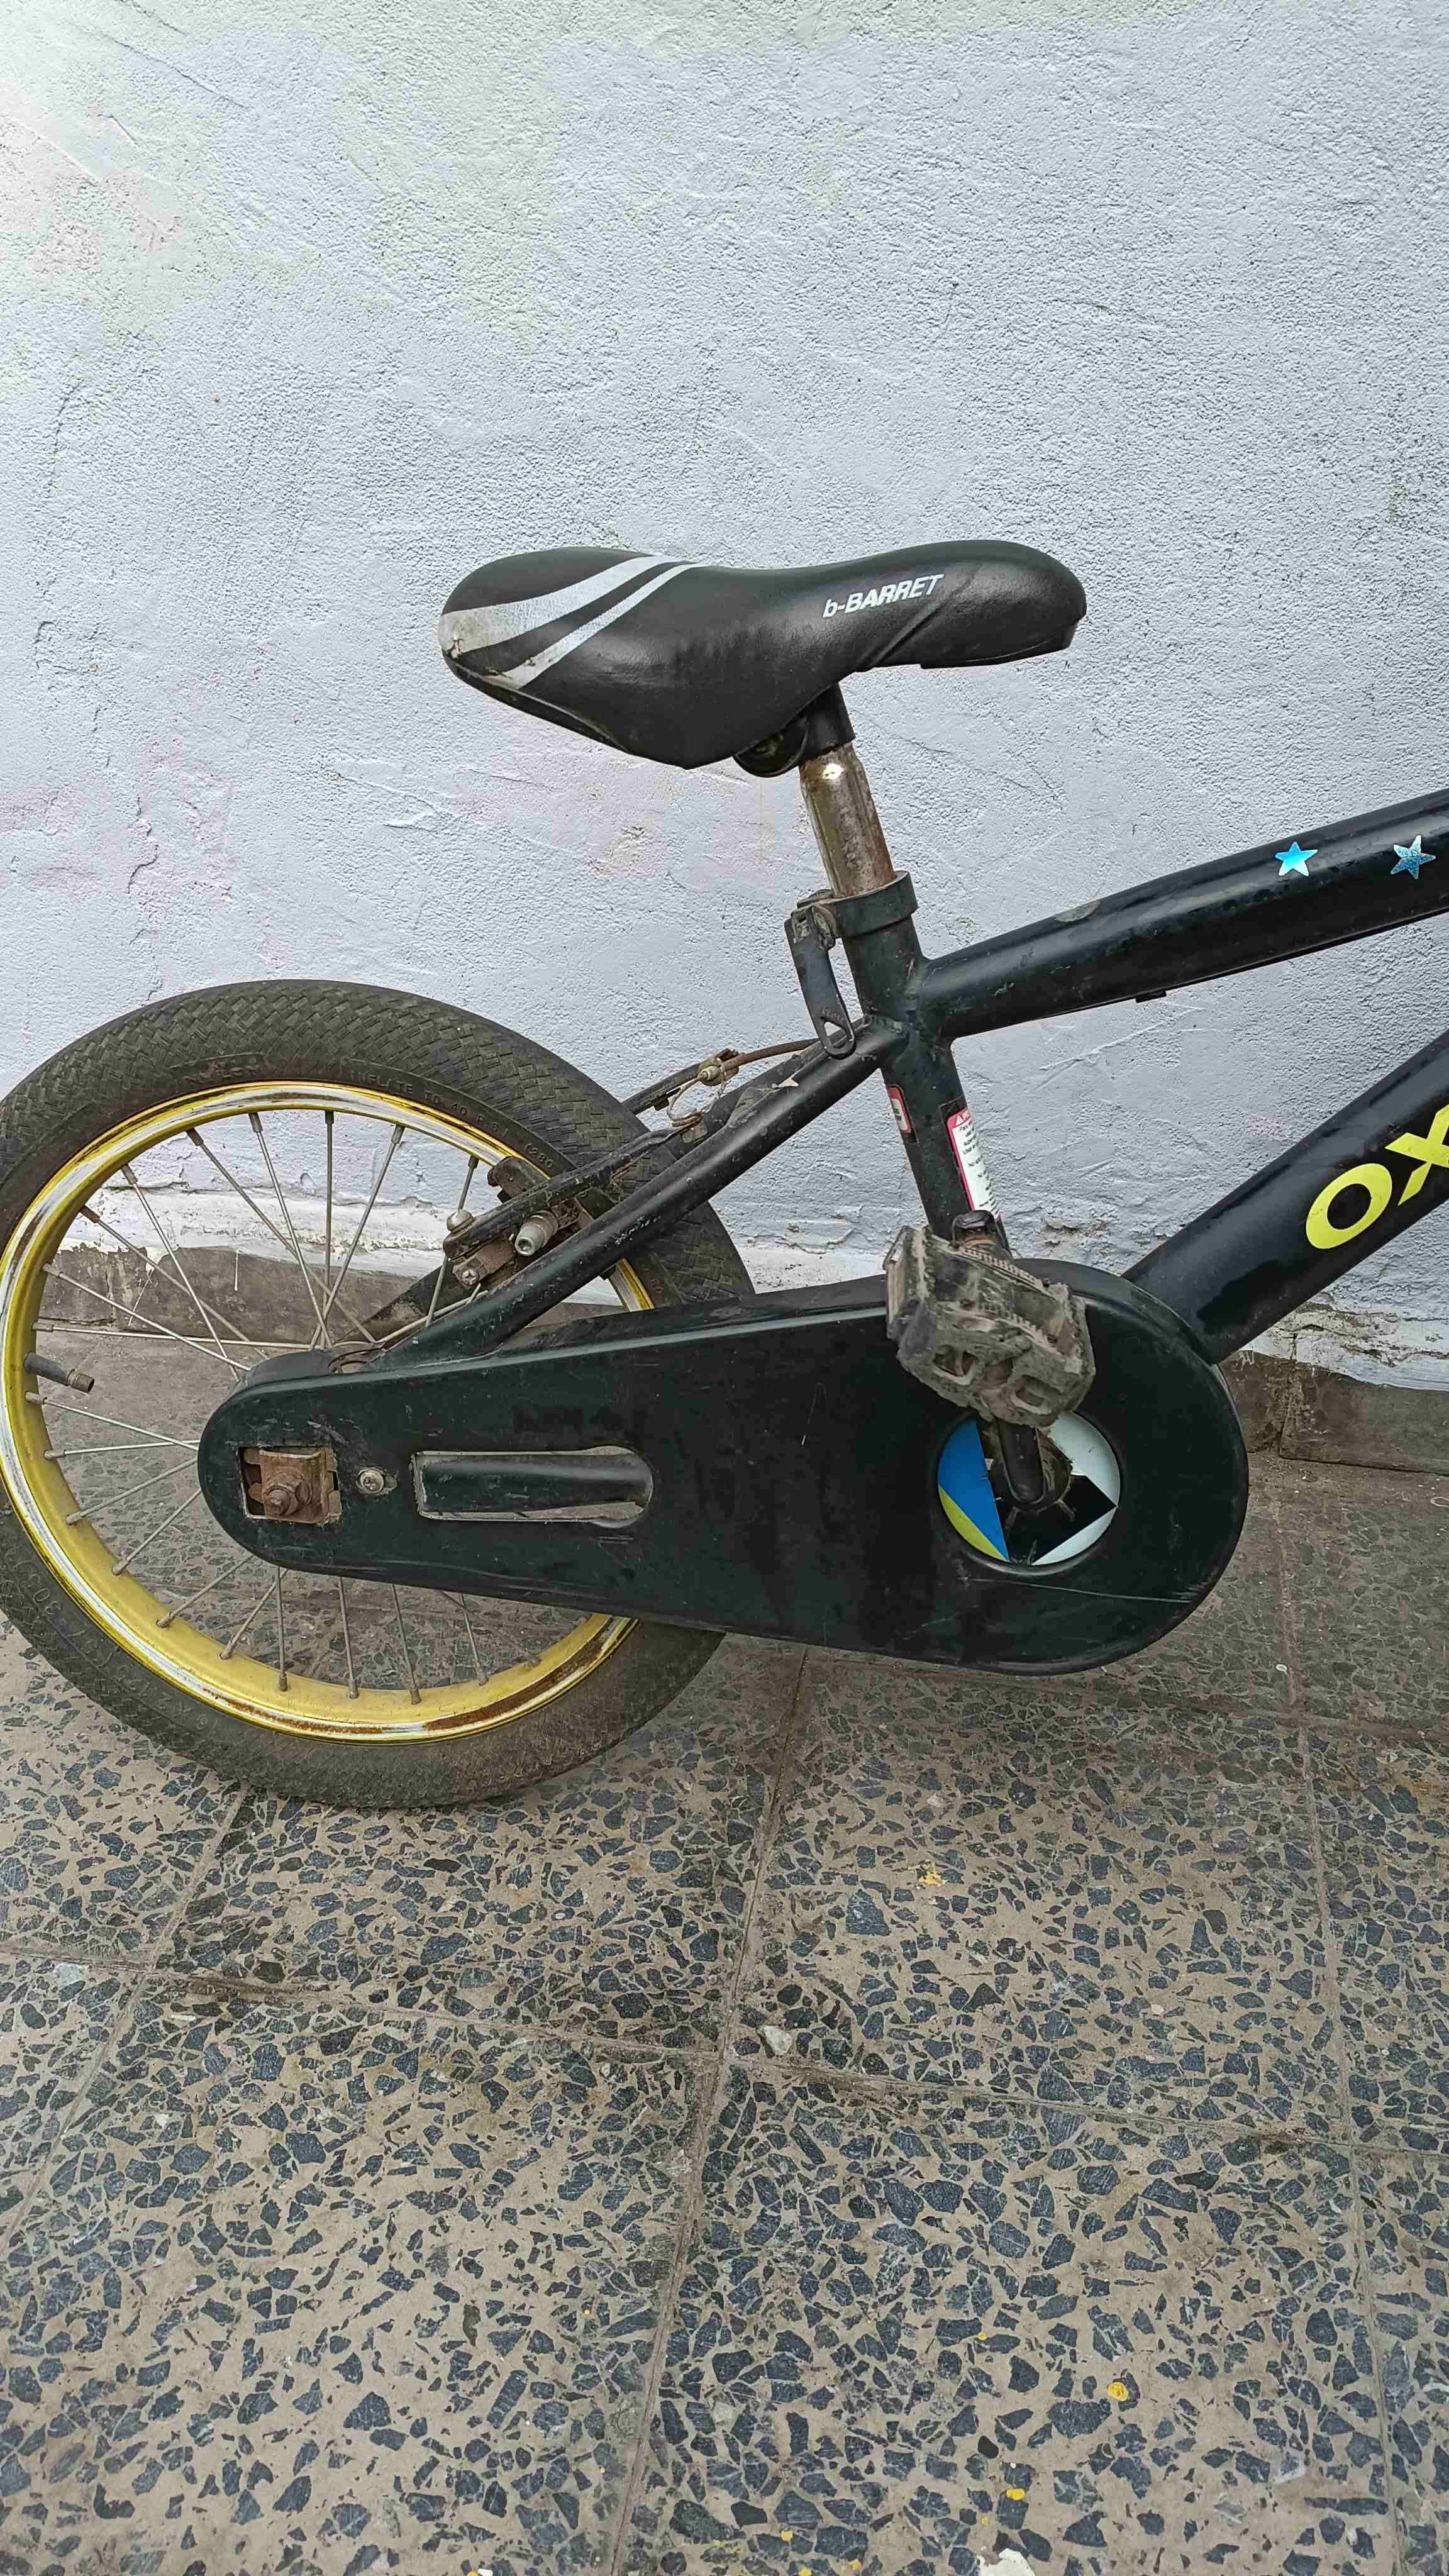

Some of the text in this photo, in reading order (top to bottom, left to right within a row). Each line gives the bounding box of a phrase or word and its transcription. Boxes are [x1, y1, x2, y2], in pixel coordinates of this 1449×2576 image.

[823, 574, 944, 618] b-BARRET
[351, 1070, 413, 1095] INFLATE
[423, 1089, 441, 1104] TO
[1306, 1104, 1449, 1249] OX
